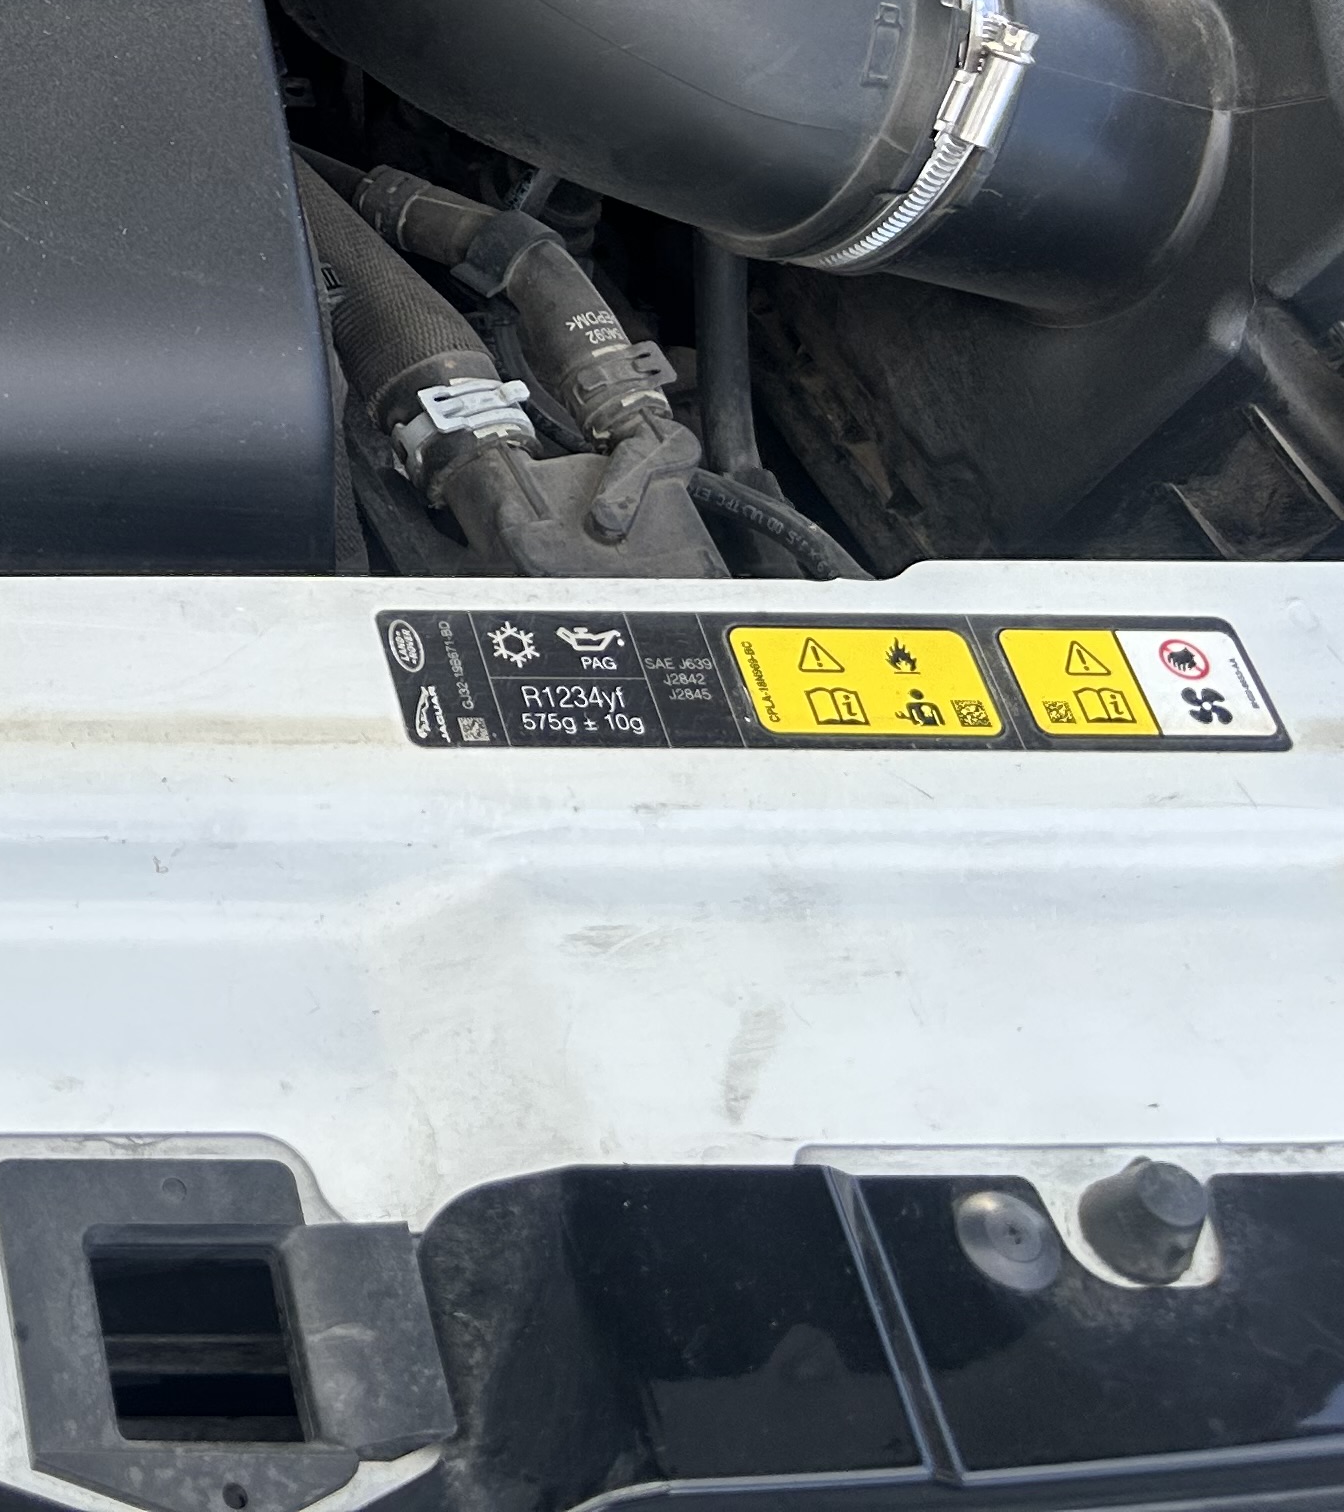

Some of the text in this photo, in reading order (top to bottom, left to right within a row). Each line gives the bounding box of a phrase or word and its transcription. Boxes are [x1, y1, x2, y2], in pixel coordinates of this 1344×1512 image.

[395, 636, 410, 662] LAND
[581, 656, 617, 670] PAG
[644, 657, 712, 670] SAE J639
[663, 673, 706, 686] J2842
[521, 685, 626, 712] R1234yf
[669, 688, 712, 700] J2845
[428, 686, 451, 743] JAGUAR
[521, 713, 577, 734] 575g
[604, 713, 645, 734] 10g
